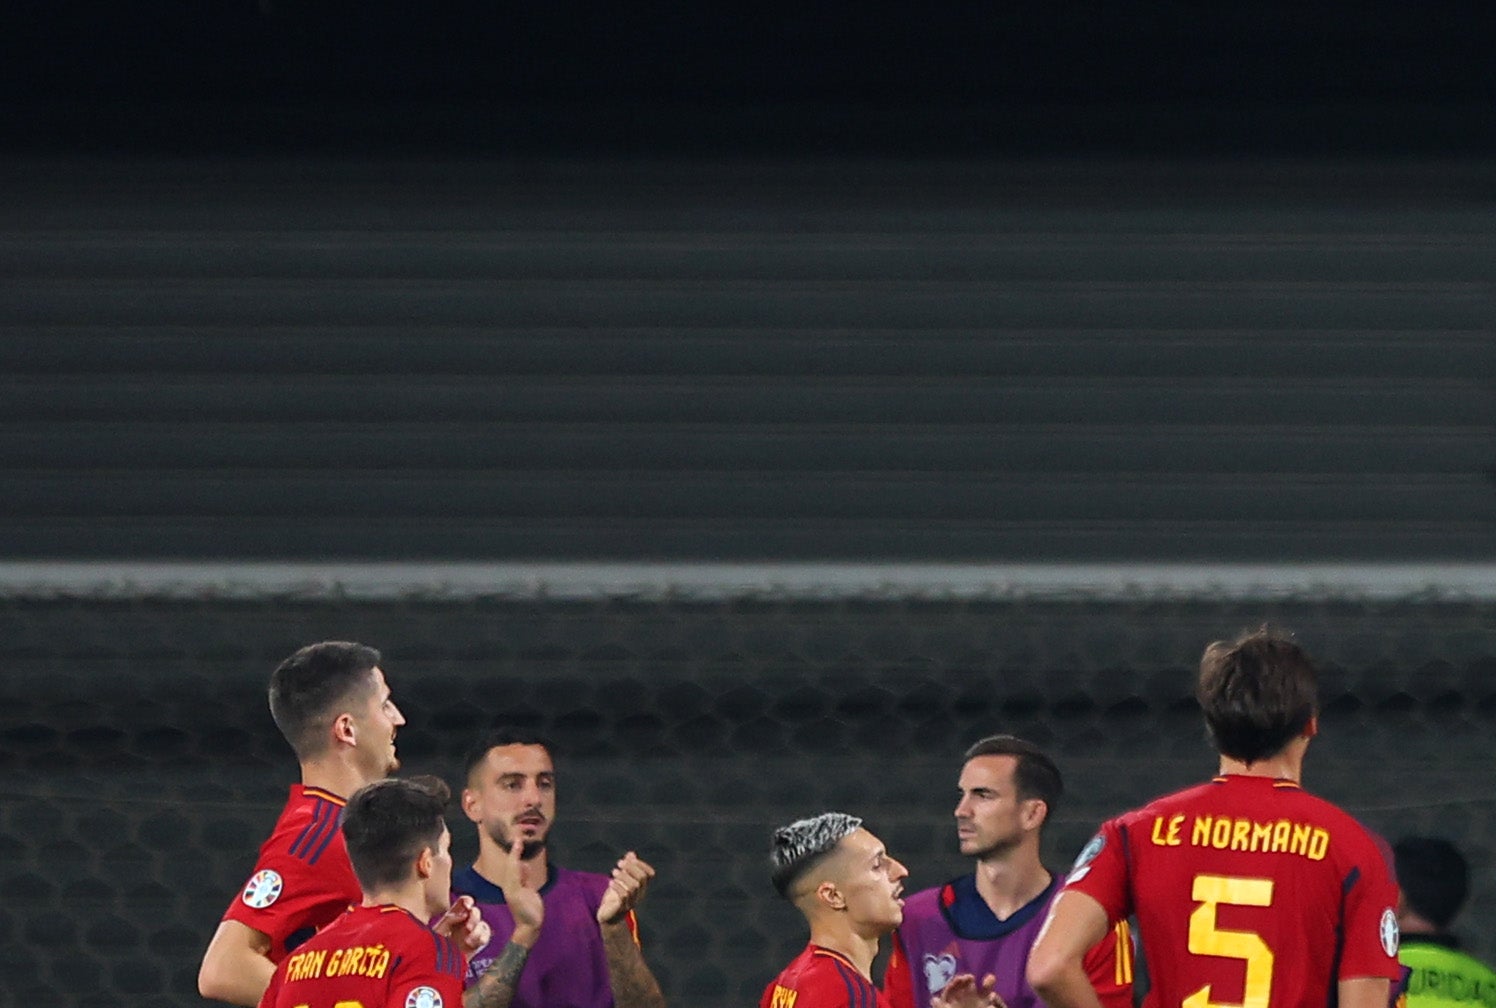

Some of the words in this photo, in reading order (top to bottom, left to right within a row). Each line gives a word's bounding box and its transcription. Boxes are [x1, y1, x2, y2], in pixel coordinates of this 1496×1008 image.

[1151, 815, 1185, 846] LE
[1192, 817, 1330, 861] NORMAND
[285, 949, 327, 984] FRAN
[326, 944, 390, 979] GARCÍA
